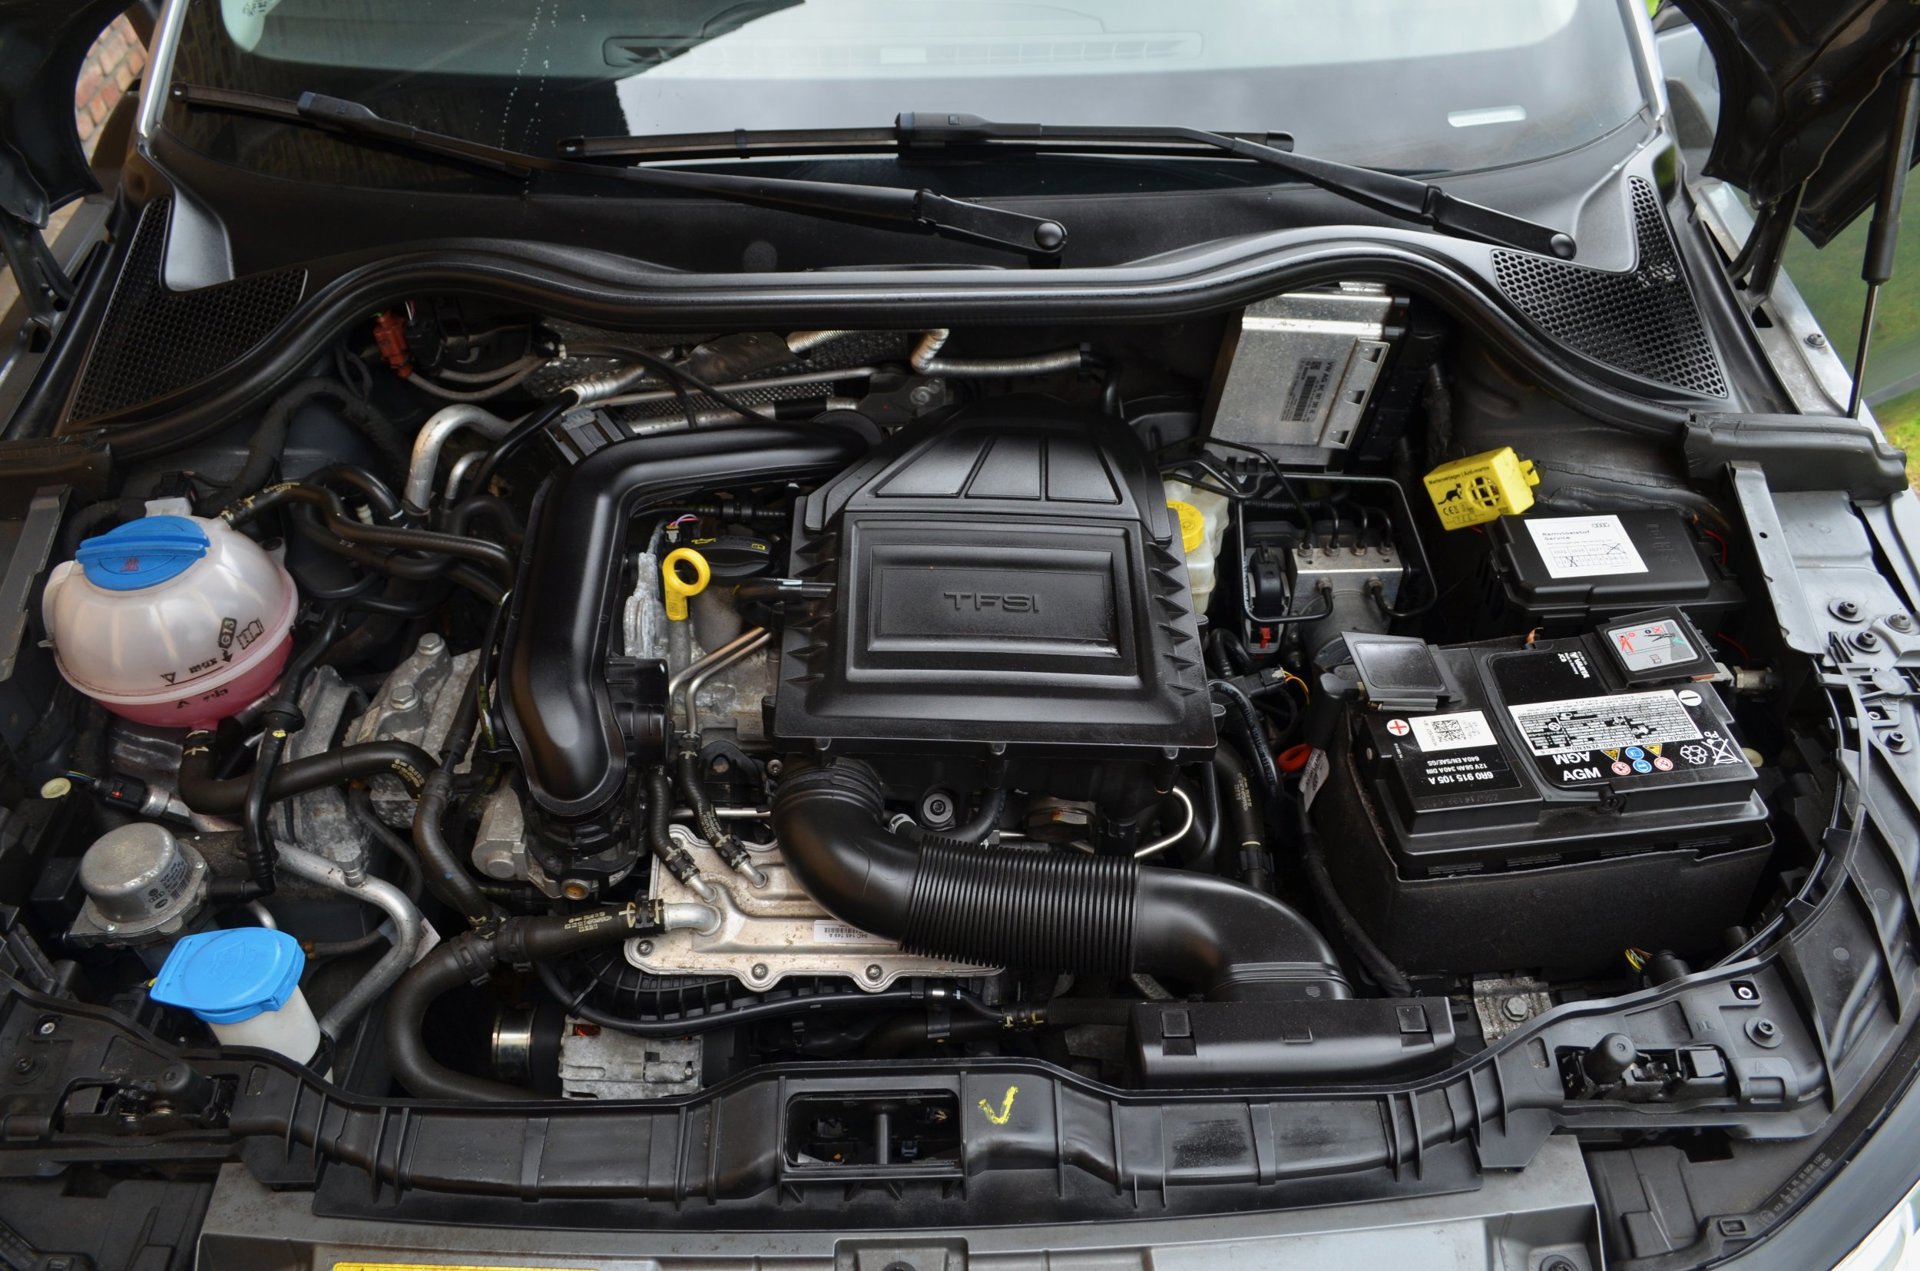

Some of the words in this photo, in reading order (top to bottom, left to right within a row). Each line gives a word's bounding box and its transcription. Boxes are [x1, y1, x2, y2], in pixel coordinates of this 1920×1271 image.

[943, 592, 1040, 613] TFSI
[1552, 751, 1590, 765] AGM
[1456, 773, 1475, 783] 915
[1475, 771, 1494, 780] 6R0
[1563, 767, 1602, 782] AGM
[1427, 777, 1436, 785] A
[1437, 775, 1455, 785] 105
